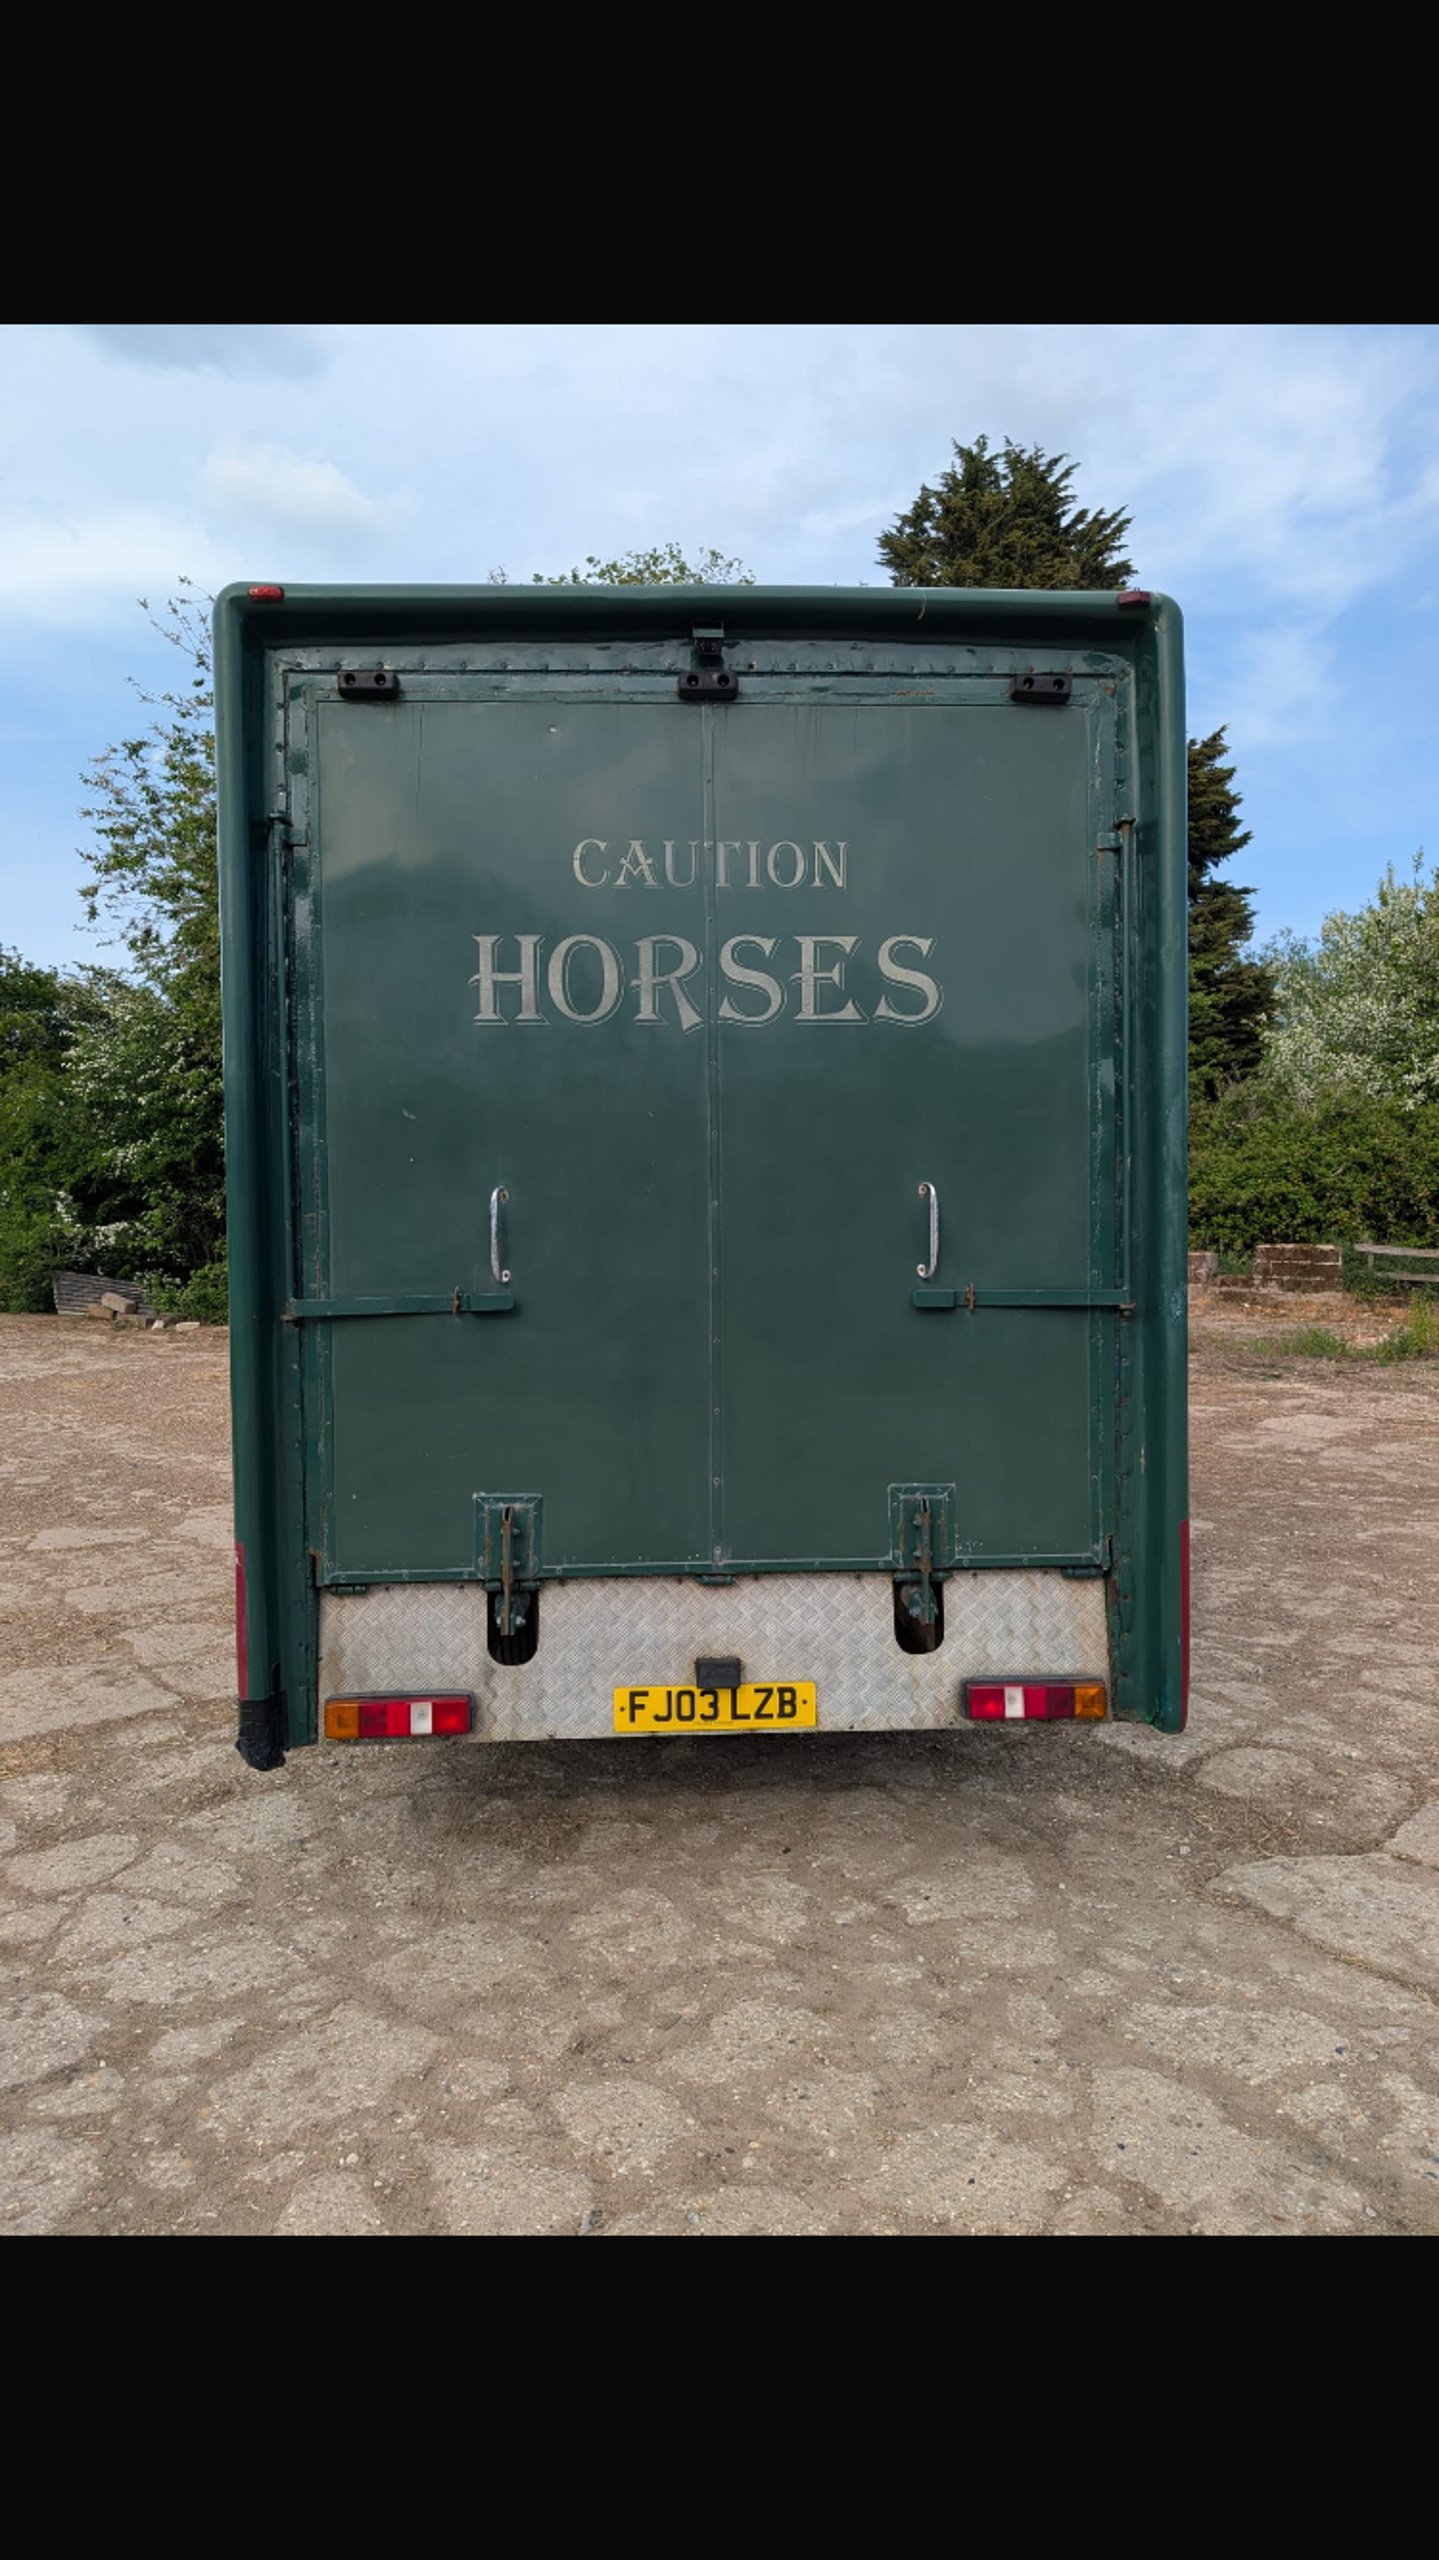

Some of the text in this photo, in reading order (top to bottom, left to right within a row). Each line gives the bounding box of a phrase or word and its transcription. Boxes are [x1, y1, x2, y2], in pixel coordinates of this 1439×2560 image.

[572, 838, 849, 890] CAUTION
[468, 933, 944, 1034] HORSES
[629, 1687, 797, 1723] FJ03 LZB
